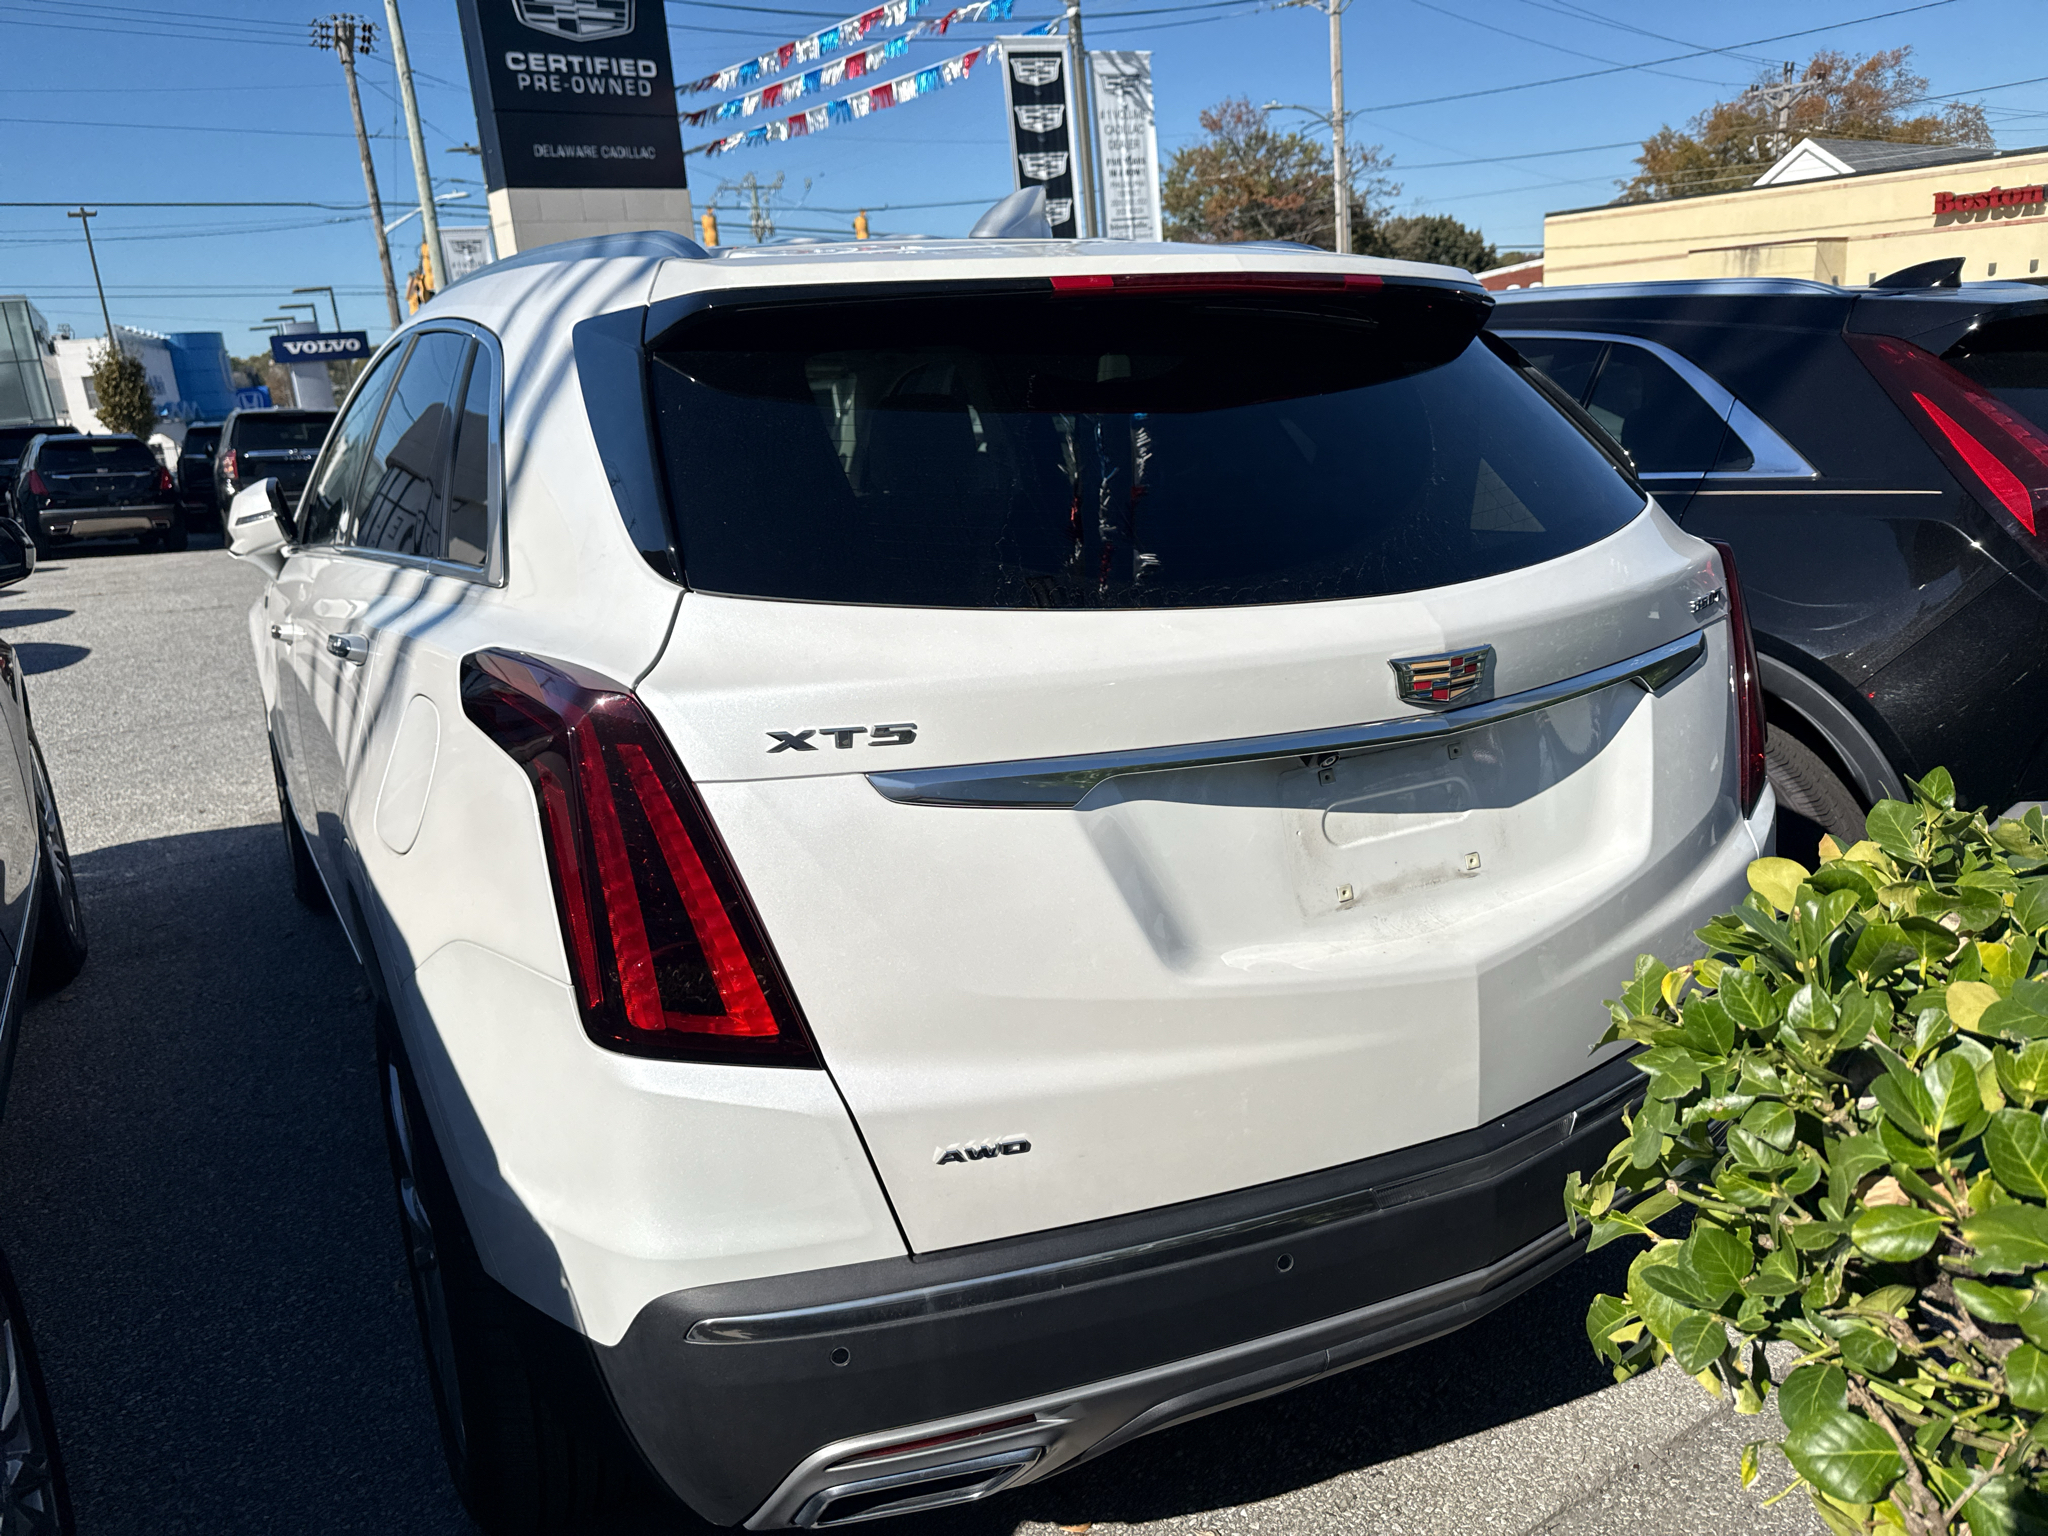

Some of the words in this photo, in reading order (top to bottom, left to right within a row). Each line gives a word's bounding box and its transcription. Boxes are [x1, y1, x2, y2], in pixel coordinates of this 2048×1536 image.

[505, 51, 657, 78] CERTIFIED
[518, 74, 652, 97] PRE-OWNED
[534, 144, 598, 158] DELAWARE
[600, 145, 656, 159] CADILLAC
[1932, 186, 2044, 215] Boston
[283, 338, 361, 355] VOLVO
[766, 721, 918, 753] XT5
[936, 1138, 1032, 1164] AWD
